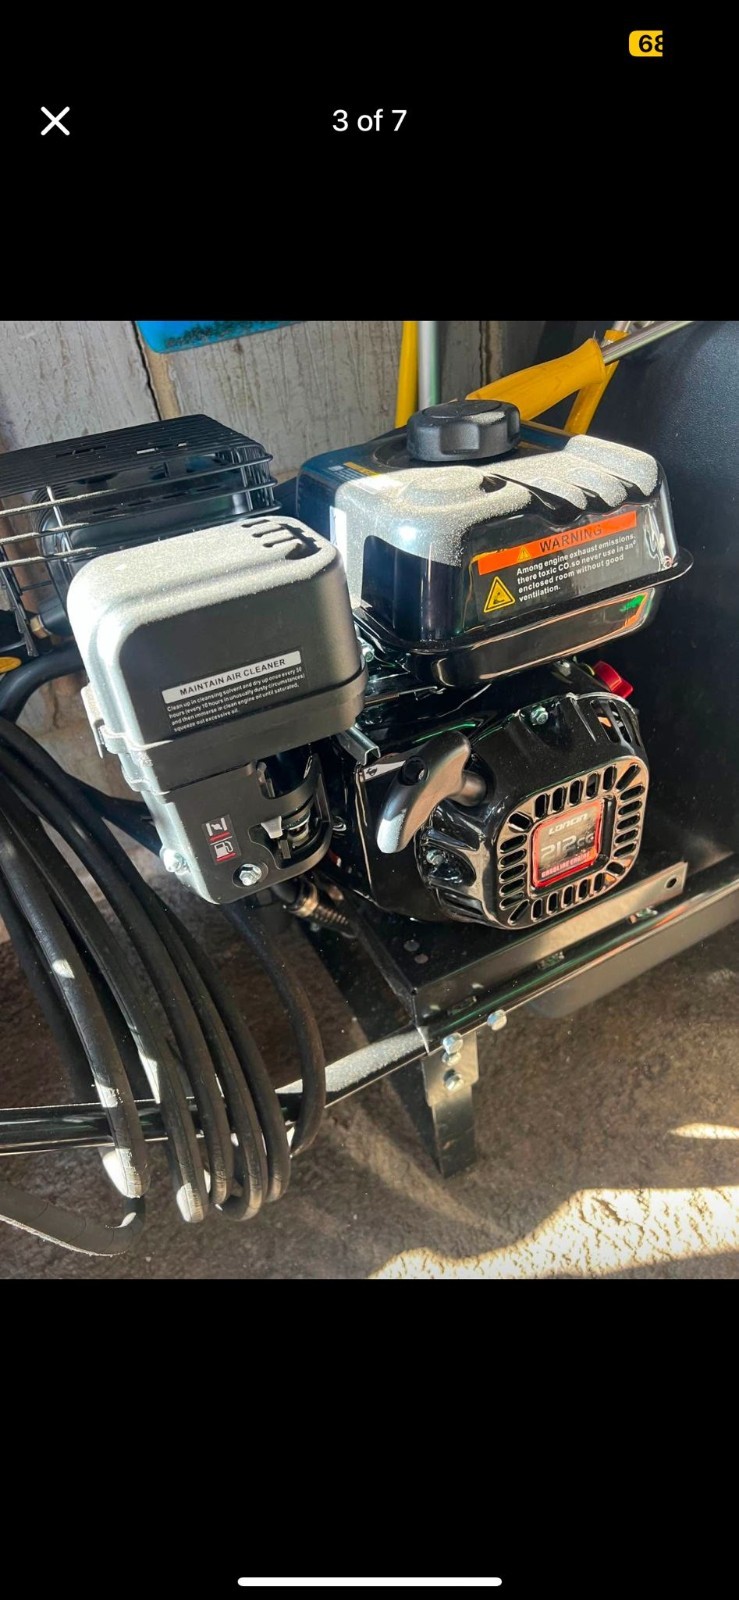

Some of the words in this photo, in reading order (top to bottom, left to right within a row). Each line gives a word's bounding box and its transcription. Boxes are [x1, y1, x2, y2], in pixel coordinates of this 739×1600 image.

[539, 525, 602, 553] WARNING
[516, 562, 543, 576] Among
[544, 554, 569, 566] engine
[569, 543, 598, 559] exhaust
[517, 573, 537, 585] there
[538, 567, 557, 578] toxic
[581, 553, 602, 564] never
[602, 548, 616, 557] use
[616, 545, 624, 553] in
[518, 576, 554, 594] enclosed
[555, 570, 575, 582] room
[576, 560, 604, 575] without
[605, 553, 624, 567] good
[518, 584, 561, 602] ventilation.
[179, 677, 225, 696] MAINTAIN
[226, 672, 242, 682] AIR
[243, 658, 286, 677] CLEANER
[167, 703, 183, 712] Clean
